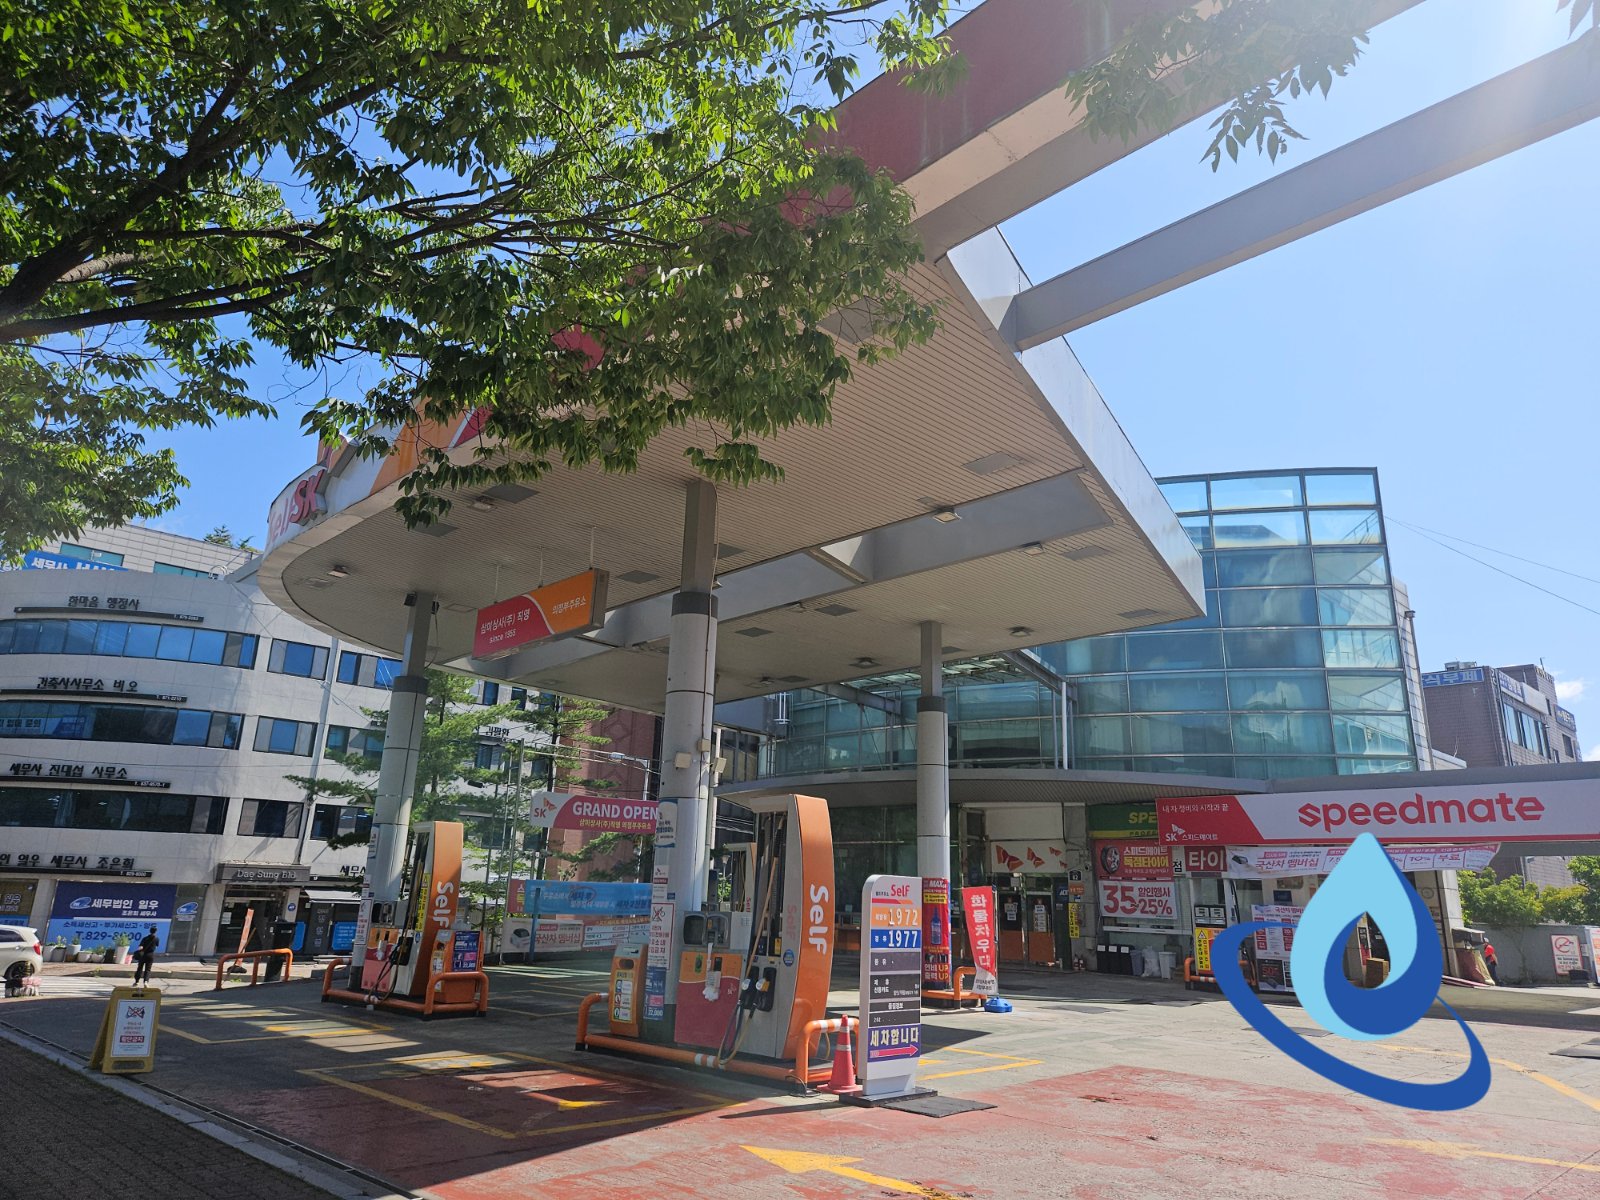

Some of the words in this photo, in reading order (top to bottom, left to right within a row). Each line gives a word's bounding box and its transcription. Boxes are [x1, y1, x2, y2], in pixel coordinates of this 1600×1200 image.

[289, 469, 322, 523] SK
[68, 595, 99, 608] 한마음
[107, 597, 140, 610] 행정사
[37, 676, 105, 691] 건축사사무소
[10, 762, 42, 776] 세무사
[92, 766, 128, 779] 사무소
[533, 806, 547, 819] SK
[572, 801, 621, 818] GRAND
[623, 805, 658, 820] OPEN
[1298, 792, 1545, 833] speedmate
[1165, 833, 1178, 842] SK
[50, 855, 88, 869] 세무사
[1123, 856, 1169, 868] 독점타이어
[237, 870, 255, 879] Dae
[257, 870, 280, 880] Sung
[281, 871, 296, 880] Bld
[890, 884, 910, 897] Self
[1138, 887, 1171, 898] 할인행사
[92, 898, 133, 910] 세무법인
[433, 880, 454, 928] Self
[809, 883, 829, 956] Self
[889, 908, 918, 926] 1972
[888, 930, 918, 948] 1977
[938, 964, 949, 972] UP
[938, 972, 949, 980] UP
[870, 1027, 919, 1047] 세차합니다
